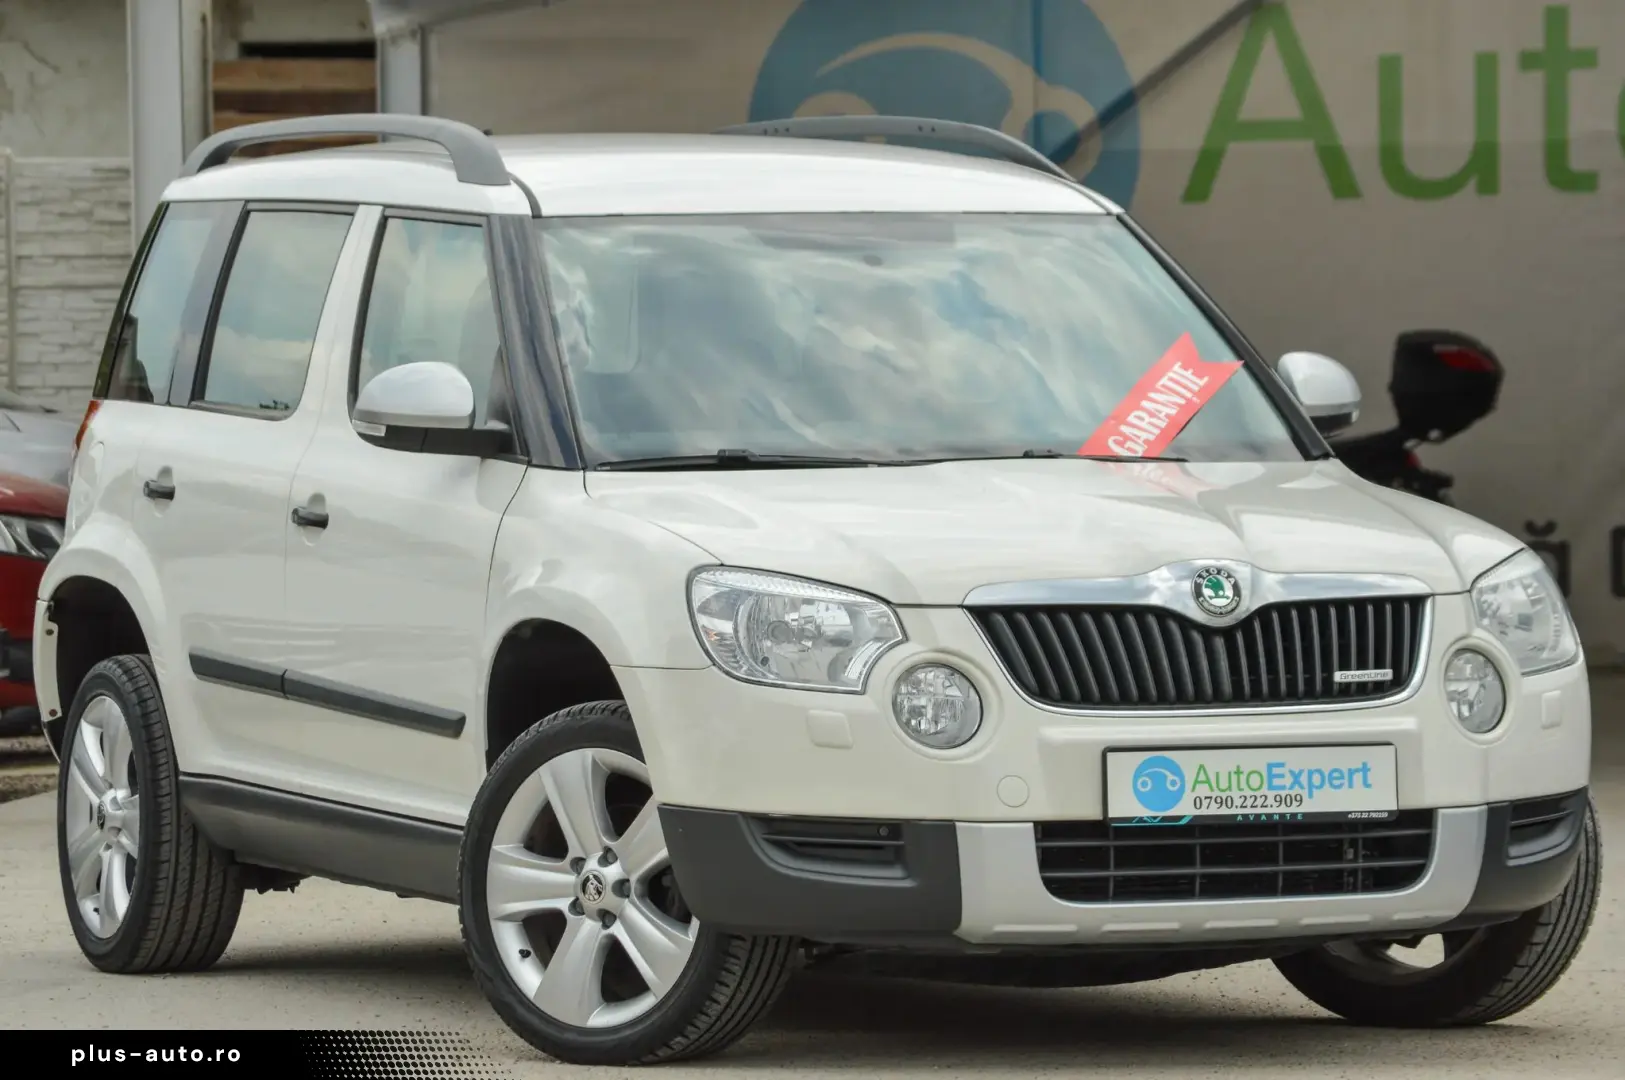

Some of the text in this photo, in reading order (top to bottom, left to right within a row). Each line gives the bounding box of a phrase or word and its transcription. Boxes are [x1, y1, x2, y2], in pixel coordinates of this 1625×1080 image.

[1181, 2, 1625, 203] Aut
[1191, 761, 1372, 799] AutoExpert
[1193, 793, 1303, 810] 0790.222.909
[1236, 813, 1303, 821] AVANTE
